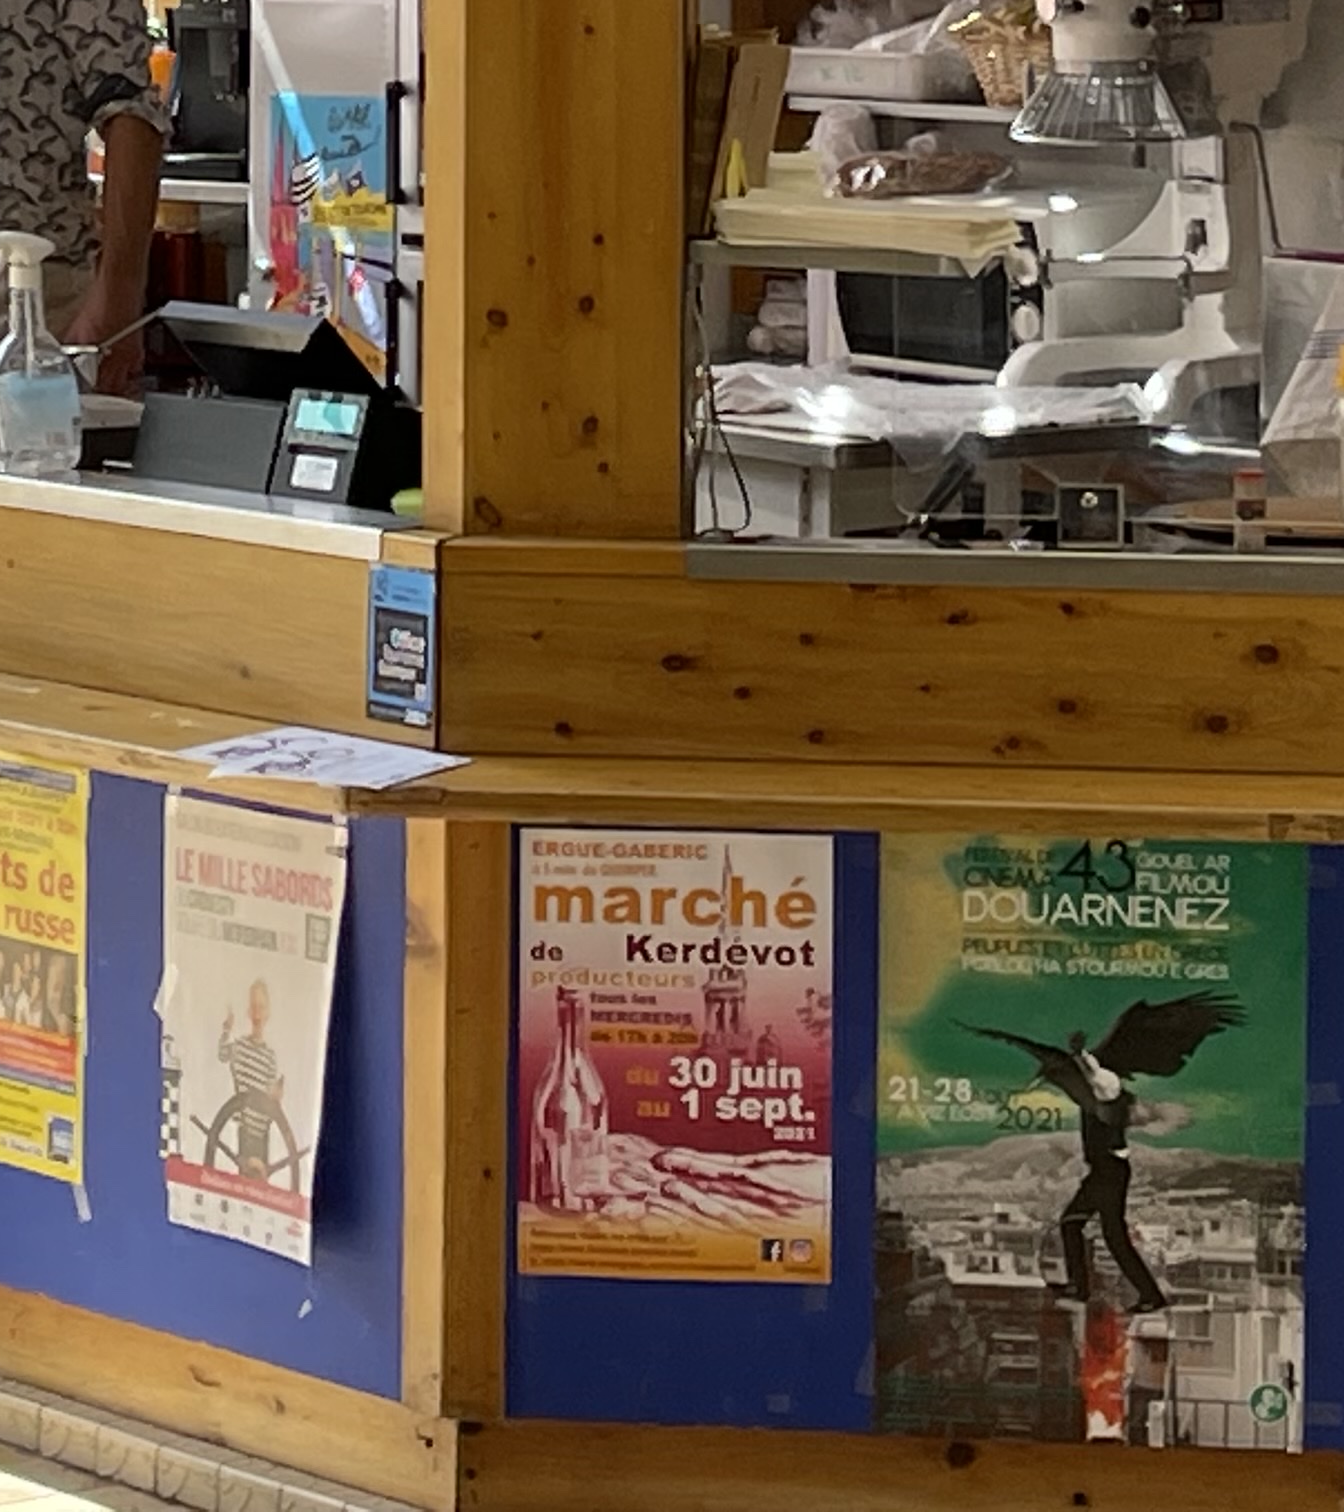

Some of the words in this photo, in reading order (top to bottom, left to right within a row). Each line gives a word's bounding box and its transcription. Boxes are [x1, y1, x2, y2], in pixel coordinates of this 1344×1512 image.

[39, 859, 75, 903] de
[176, 847, 194, 883] LE
[1058, 839, 1136, 892] 43
[533, 875, 817, 929] marché
[962, 889, 1231, 931] DOUARNENEZ
[4, 904, 76, 945] russe
[530, 942, 564, 962] de
[625, 934, 816, 968] Kerdévot
[531, 967, 696, 990] producteurs
[626, 1066, 660, 1086] du
[668, 1056, 718, 1089] 30
[726, 1058, 804, 1095] juin
[888, 1074, 972, 1104] 21-28
[636, 1100, 672, 1119] au
[680, 1089, 701, 1121] 1
[715, 1091, 817, 1128] sept.
[997, 1104, 1063, 1132] 2021
